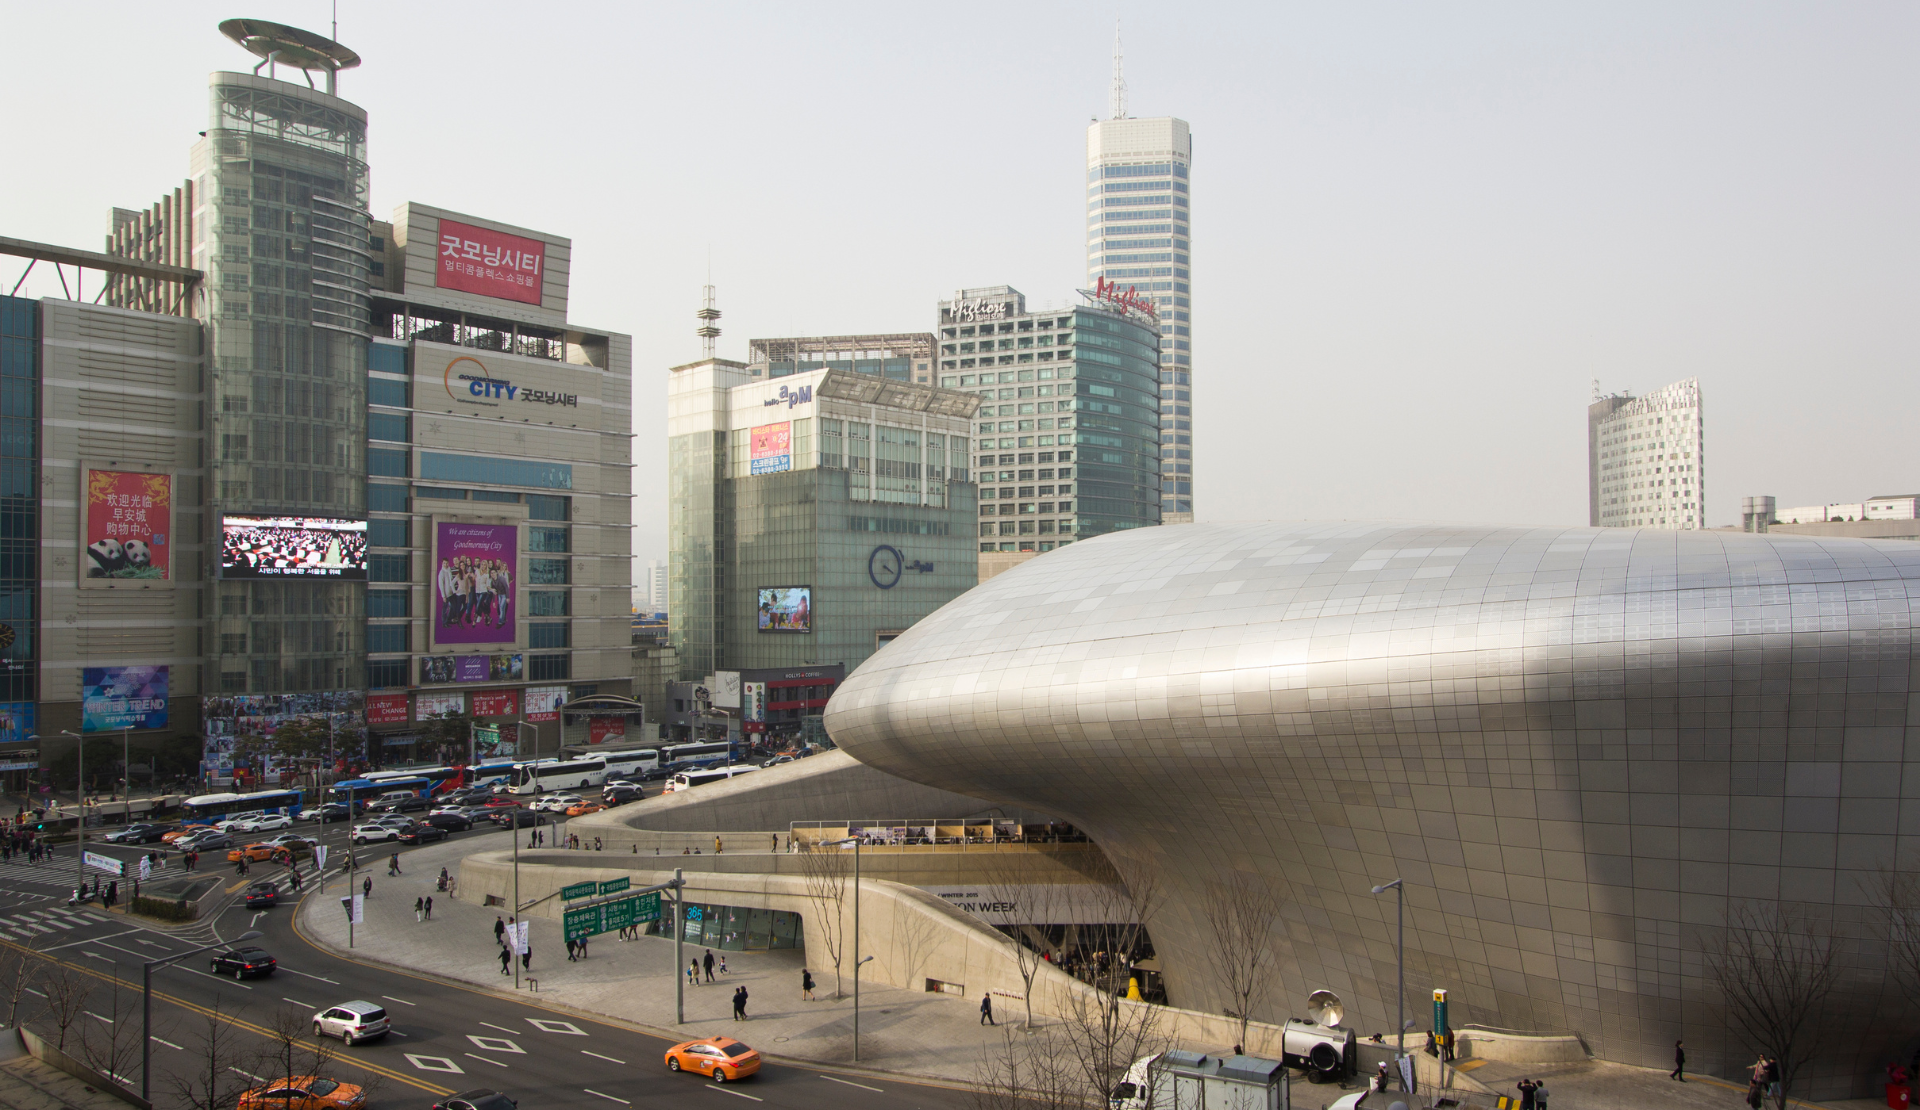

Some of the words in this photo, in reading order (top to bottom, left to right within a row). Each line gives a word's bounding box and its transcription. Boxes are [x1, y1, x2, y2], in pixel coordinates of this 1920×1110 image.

[441, 235, 540, 275] 굿모닝시티
[506, 273, 534, 287] 쇼핑몰
[1096, 276, 1154, 315] Migliore
[950, 298, 1006, 322] Migliore
[469, 381, 518, 400] CITY
[521, 388, 577, 408] 굿모닝시티
[107, 494, 152, 508] 欢迎光临
[113, 508, 147, 522] 早安城
[106, 522, 152, 536] 购物中心
[467, 528, 486, 536] citizens
[453, 540, 490, 551] Goodmorning
[490, 541, 502, 551] City
[86, 701, 126, 713] WINTER
[128, 699, 165, 711] TREND
[686, 906, 702, 921] 365
[979, 902, 1017, 912] WEEK
